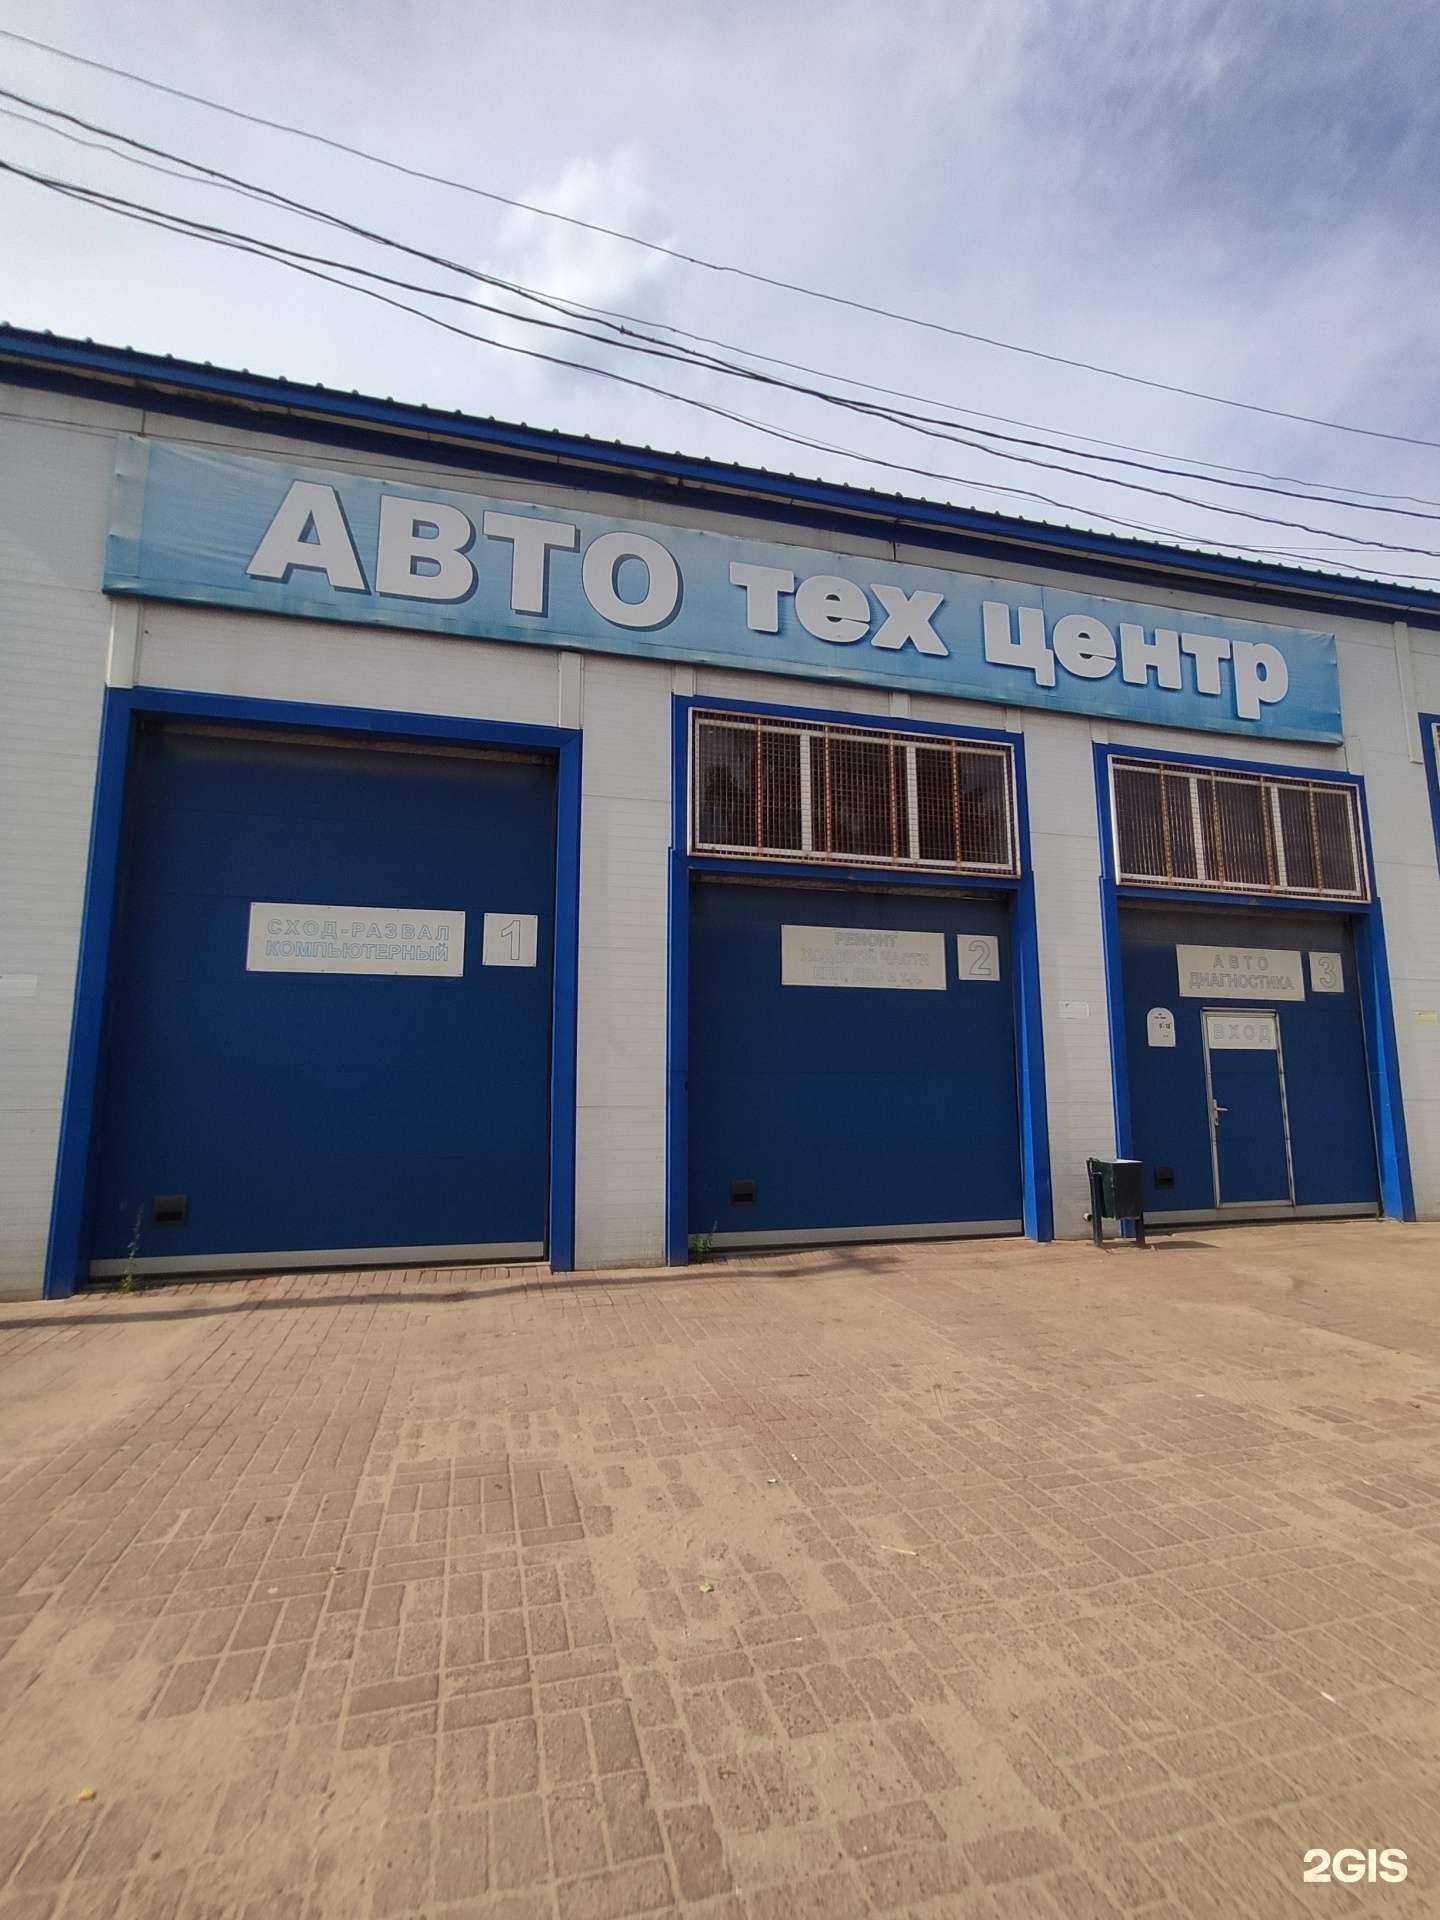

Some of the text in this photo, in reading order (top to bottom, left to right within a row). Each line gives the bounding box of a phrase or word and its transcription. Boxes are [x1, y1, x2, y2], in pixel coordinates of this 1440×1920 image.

[245, 479, 1288, 719] АВТО тех центр
[266, 918, 450, 941] СХОД-РАЗВАЛ
[500, 919, 521, 961] 1
[833, 932, 898, 947] РЕМОНТ
[264, 940, 449, 962] КОМПЬЮТЕРНЫЙ
[967, 939, 992, 976] 2
[1212, 954, 1270, 971] АВТО
[1318, 956, 1338, 989] 3
[1188, 971, 1296, 991] ДИАГНОСТИКА
[1213, 1022, 1272, 1043] ВХОД
